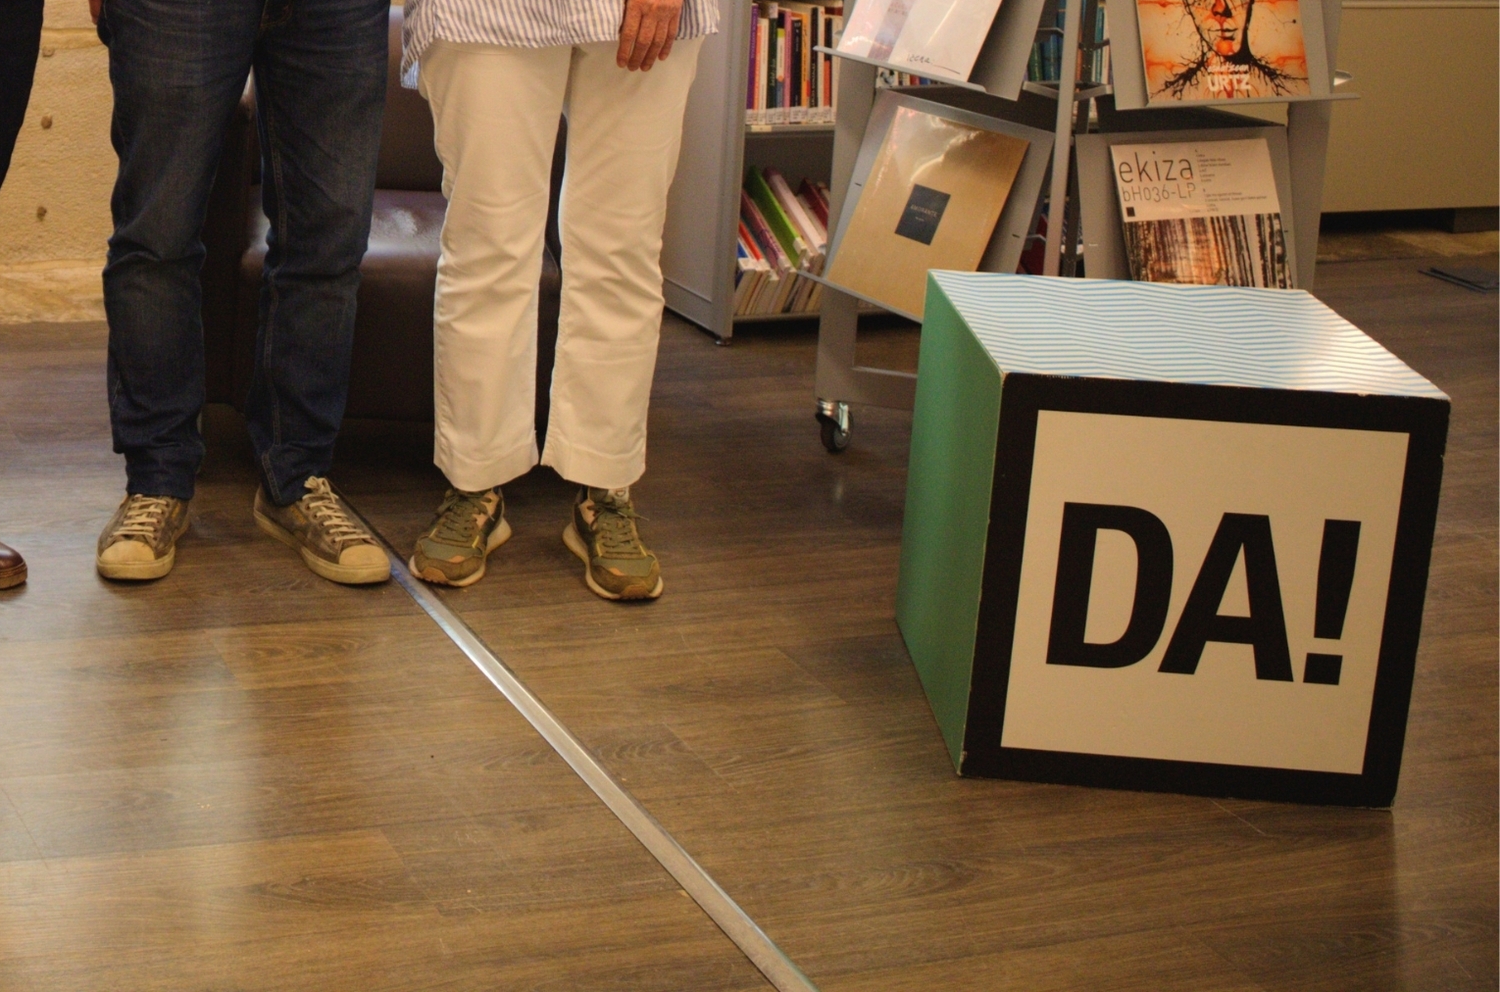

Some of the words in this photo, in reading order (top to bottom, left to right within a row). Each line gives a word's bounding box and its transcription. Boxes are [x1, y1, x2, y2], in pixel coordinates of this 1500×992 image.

[1207, 75, 1251, 92] URTZ
[1118, 150, 1194, 184] ekiza
[1121, 182, 1196, 203] bH036-LP
[1045, 501, 1362, 686] DA!
